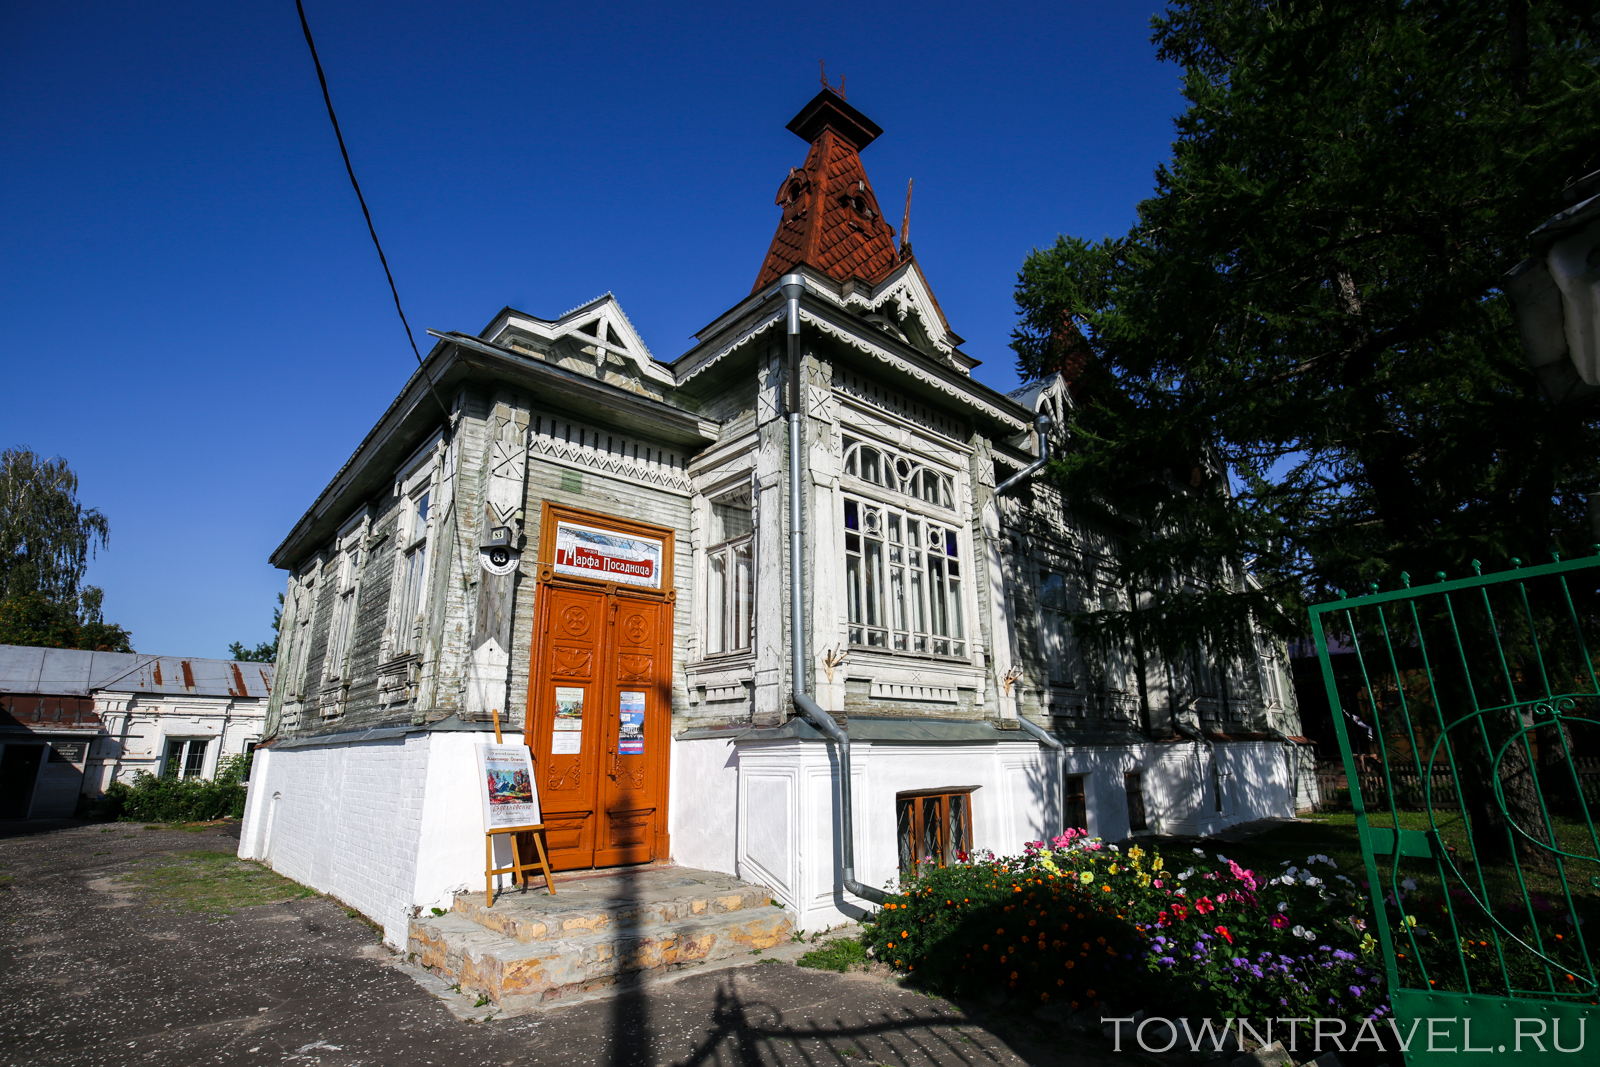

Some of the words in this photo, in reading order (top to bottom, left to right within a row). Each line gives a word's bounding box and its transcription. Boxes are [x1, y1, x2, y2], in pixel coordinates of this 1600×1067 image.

[493, 552, 506, 562] 83
[563, 541, 600, 567] Марфа
[603, 556, 650, 576] Посадница
